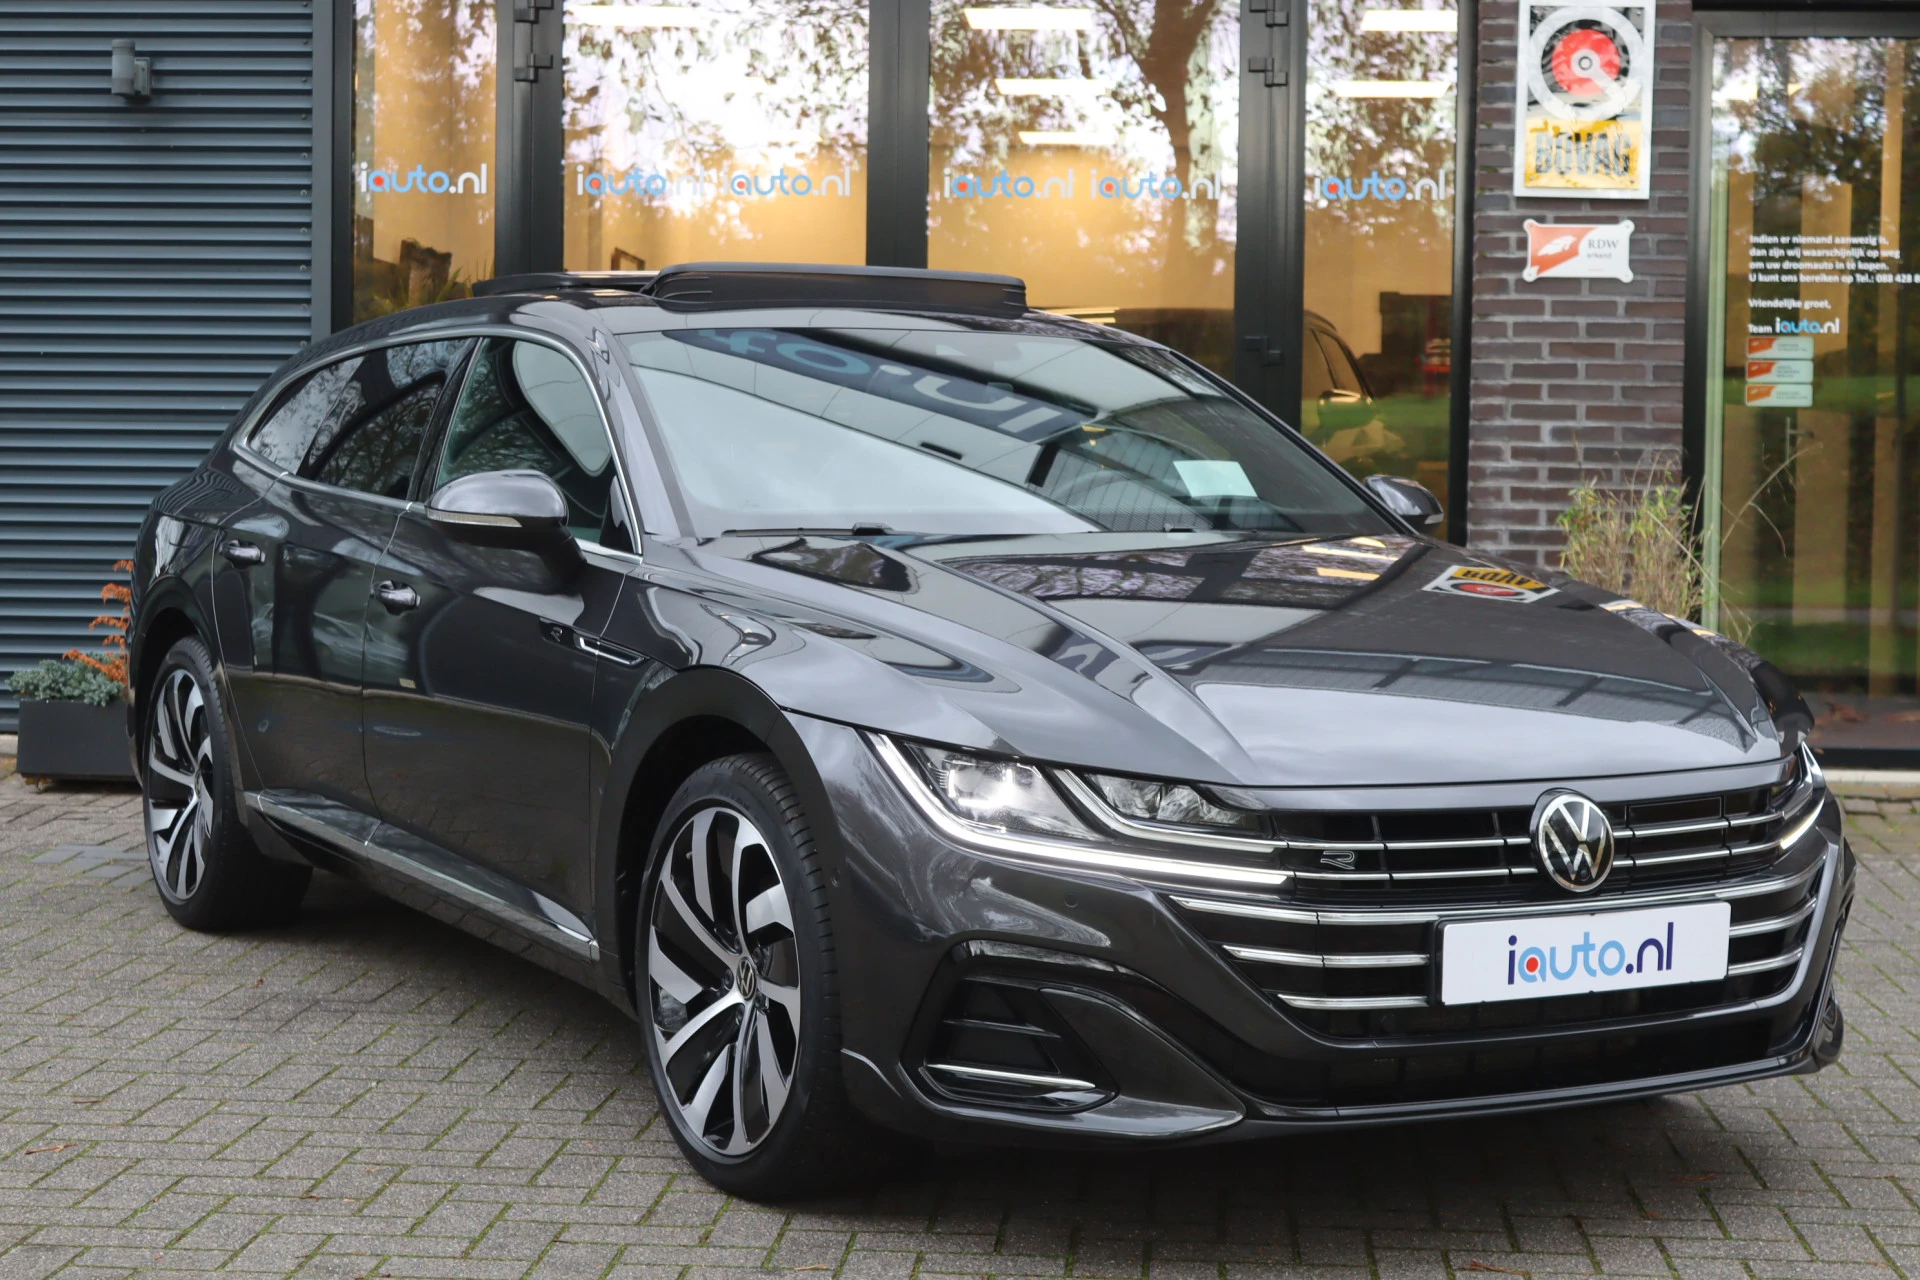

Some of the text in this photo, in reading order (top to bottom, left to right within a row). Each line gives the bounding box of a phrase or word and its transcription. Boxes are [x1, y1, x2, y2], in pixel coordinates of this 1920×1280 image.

[1535, 131, 1631, 177] BOVAG
[360, 162, 487, 194] iauto.nl
[576, 164, 851, 197] iauto.nl iauto.nl
[943, 167, 1221, 200] iauto.nl iauto.nl
[1313, 168, 1446, 201] iauto.nl
[1587, 239, 1619, 249] RDW
[1749, 234, 1779, 244] Indien
[1780, 236, 1790, 244] er
[1791, 234, 1833, 244] niemand
[1834, 235, 1877, 246] aanwezig
[1748, 247, 1901, 260] dan zijn wij waarschijnlijk op weg
[1748, 260, 1890, 272] om uw droomauto in te kopen.
[1748, 273, 1757, 283] U
[1758, 273, 1779, 283] kunt
[1781, 274, 1798, 283] ons
[1799, 273, 1840, 283] bereiken
[1841, 274, 1854, 285] op
[1748, 298, 1832, 310] Vriendelijke groet,
[1748, 317, 1840, 334] Team iauto.nl
[1507, 921, 1675, 986] iauto.nl
